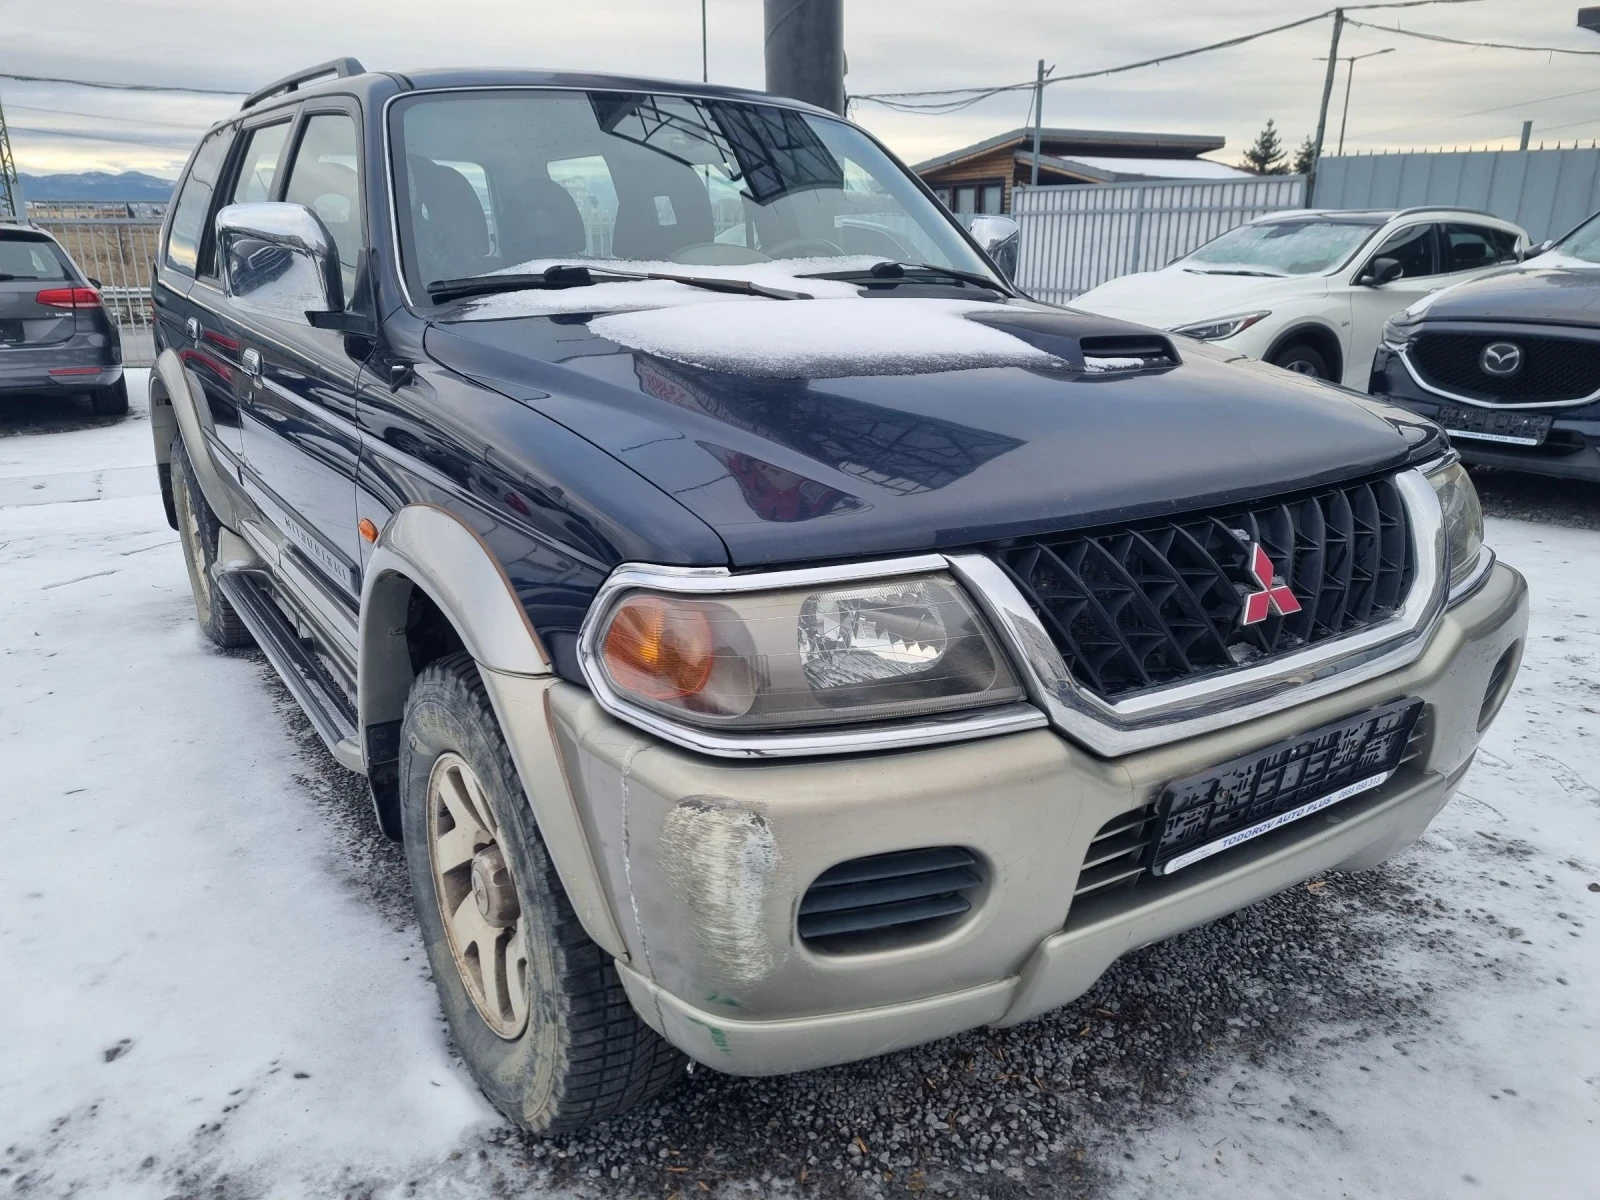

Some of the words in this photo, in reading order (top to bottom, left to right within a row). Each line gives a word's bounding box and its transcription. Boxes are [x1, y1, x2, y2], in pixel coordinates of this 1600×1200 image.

[284, 516, 347, 581] MITSUBISHI
[1222, 820, 1275, 848] TODOROV
[1275, 808, 1305, 826] AUTO
[1306, 796, 1333, 813] PLUS
